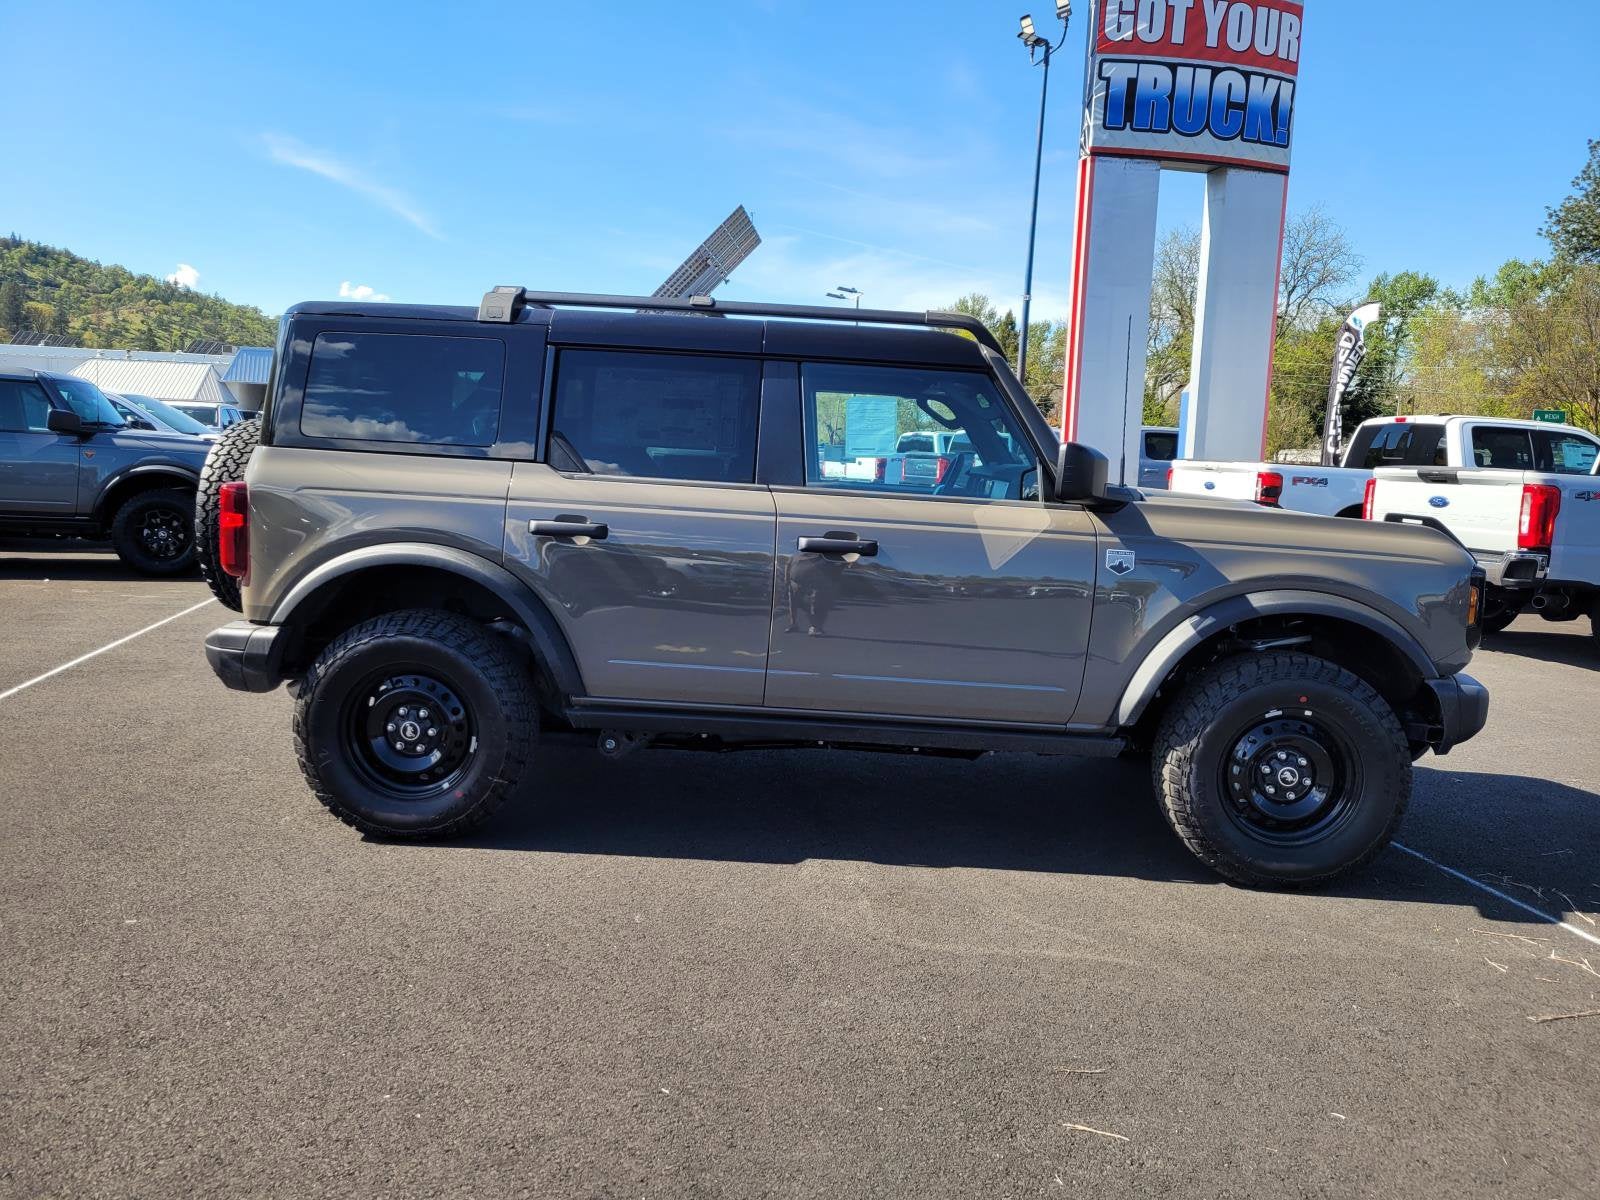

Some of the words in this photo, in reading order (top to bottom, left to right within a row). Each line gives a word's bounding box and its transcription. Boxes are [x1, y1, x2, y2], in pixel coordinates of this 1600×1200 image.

[1104, 0, 1194, 44] GOT
[1203, 0, 1301, 62] YOUR
[1100, 60, 1295, 146] TRUCK!
[1292, 476, 1328, 486] FX4
